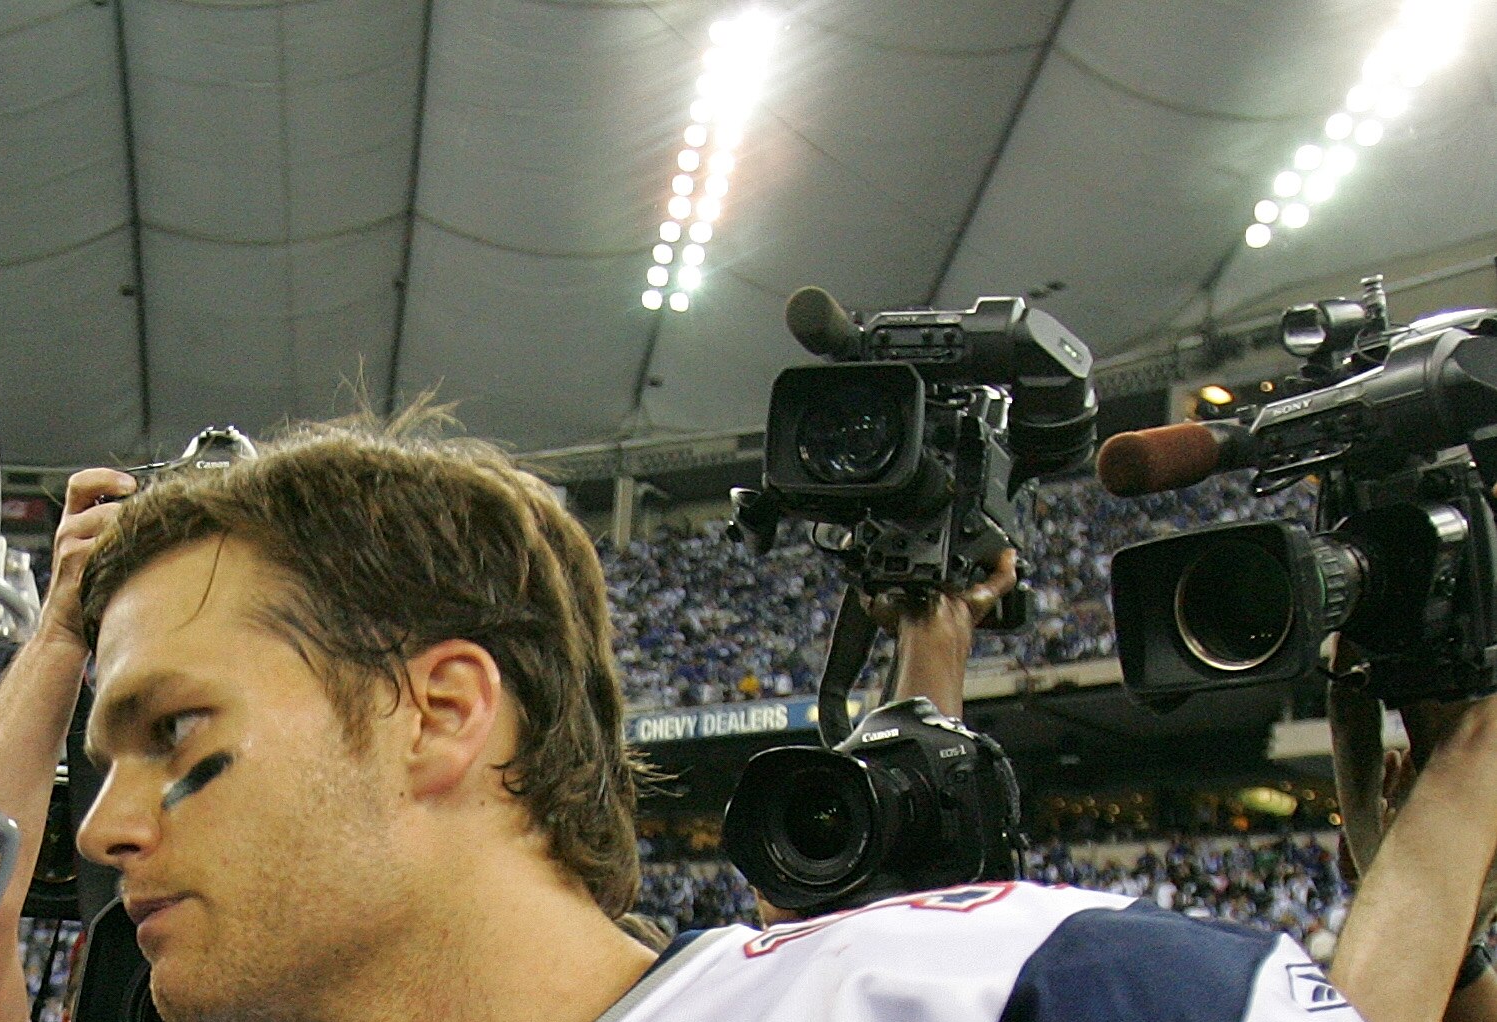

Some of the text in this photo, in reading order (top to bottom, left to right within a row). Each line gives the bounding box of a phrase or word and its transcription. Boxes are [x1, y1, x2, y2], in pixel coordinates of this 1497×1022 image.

[196, 460, 230, 469] Canon
[639, 703, 788, 742] CHEVY DEALERS
[862, 728, 899, 743] Canon
